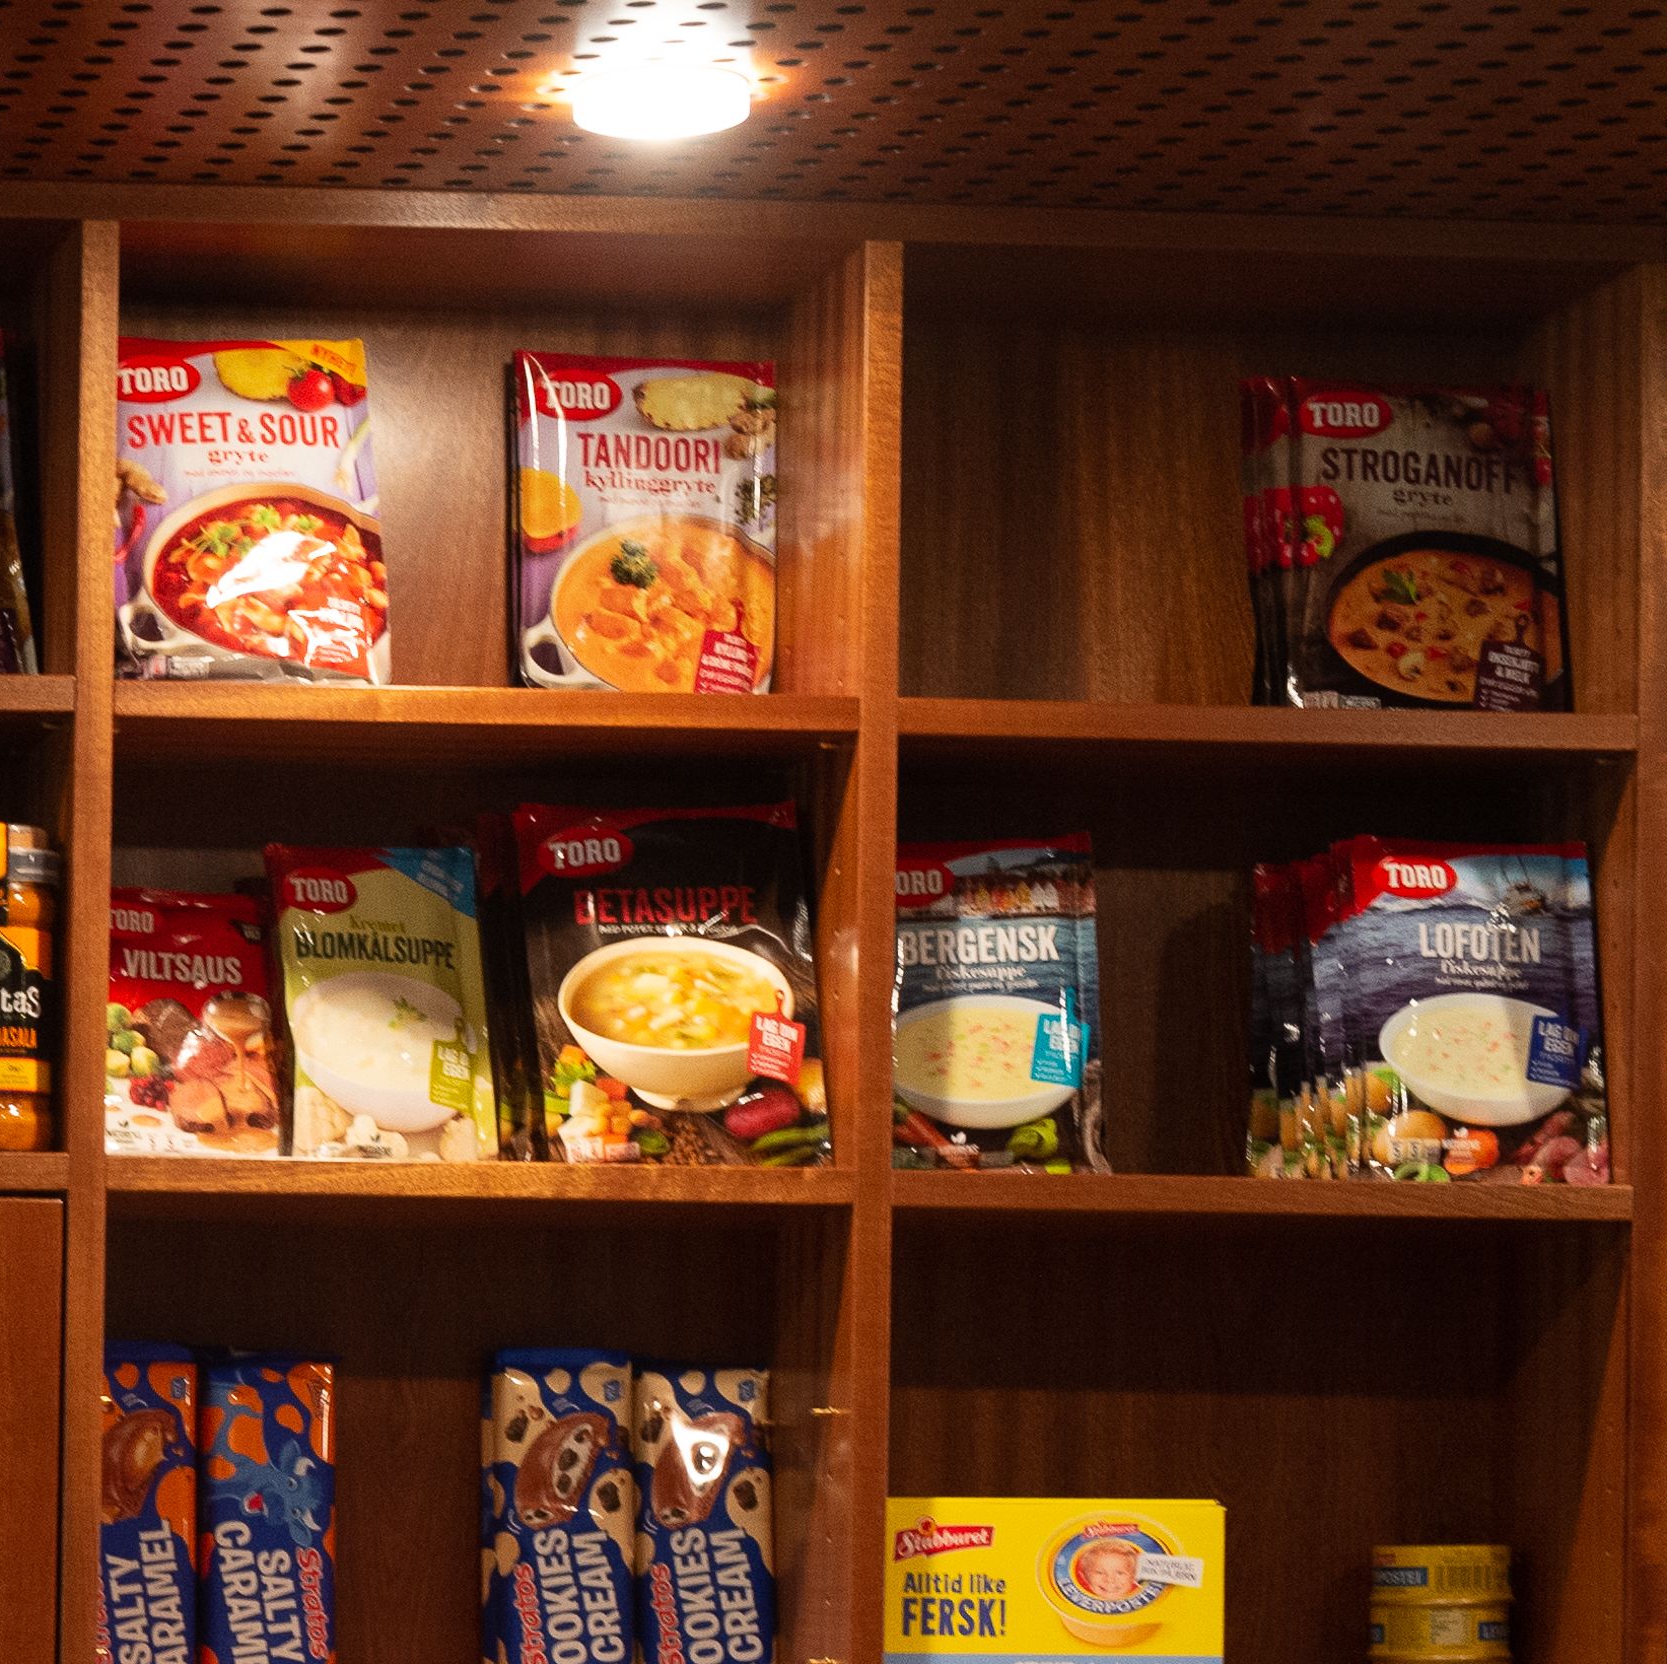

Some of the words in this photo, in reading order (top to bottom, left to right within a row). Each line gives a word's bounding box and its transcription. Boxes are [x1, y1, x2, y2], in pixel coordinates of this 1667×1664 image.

[118, 364, 188, 393] TORO
[544, 380, 610, 410] TORO
[127, 411, 231, 450] SWEET
[237, 417, 255, 444] &
[260, 412, 340, 448] SOUR
[1306, 402, 1380, 427] TORO
[208, 446, 269, 467] gryte
[578, 432, 721, 474] TANDOORI
[1321, 447, 1517, 495] STROGANOFF
[584, 469, 717, 494] kyllinggryte
[548, 838, 621, 869] TORO
[289, 877, 349, 904] TORO
[895, 869, 944, 896] ORO
[1384, 861, 1448, 890] TORO
[109, 908, 155, 934] TORO
[574, 886, 759, 926] BETASUPPE
[295, 929, 455, 971] BLOMKÅLSUPPE
[901, 925, 1060, 966] BERGENSK
[1418, 921, 1542, 965] LOFOTEN
[122, 947, 242, 985] VILTSAUS
[575, 1530, 623, 1663] CREAM
[711, 1529, 762, 1662] CREAM
[904, 1572, 962, 1594] Alltid
[970, 1573, 1006, 1595] like
[257, 1548, 305, 1664] SALTY
[295, 1546, 329, 1660] Stratos
[902, 1598, 1007, 1637] FERSK!
